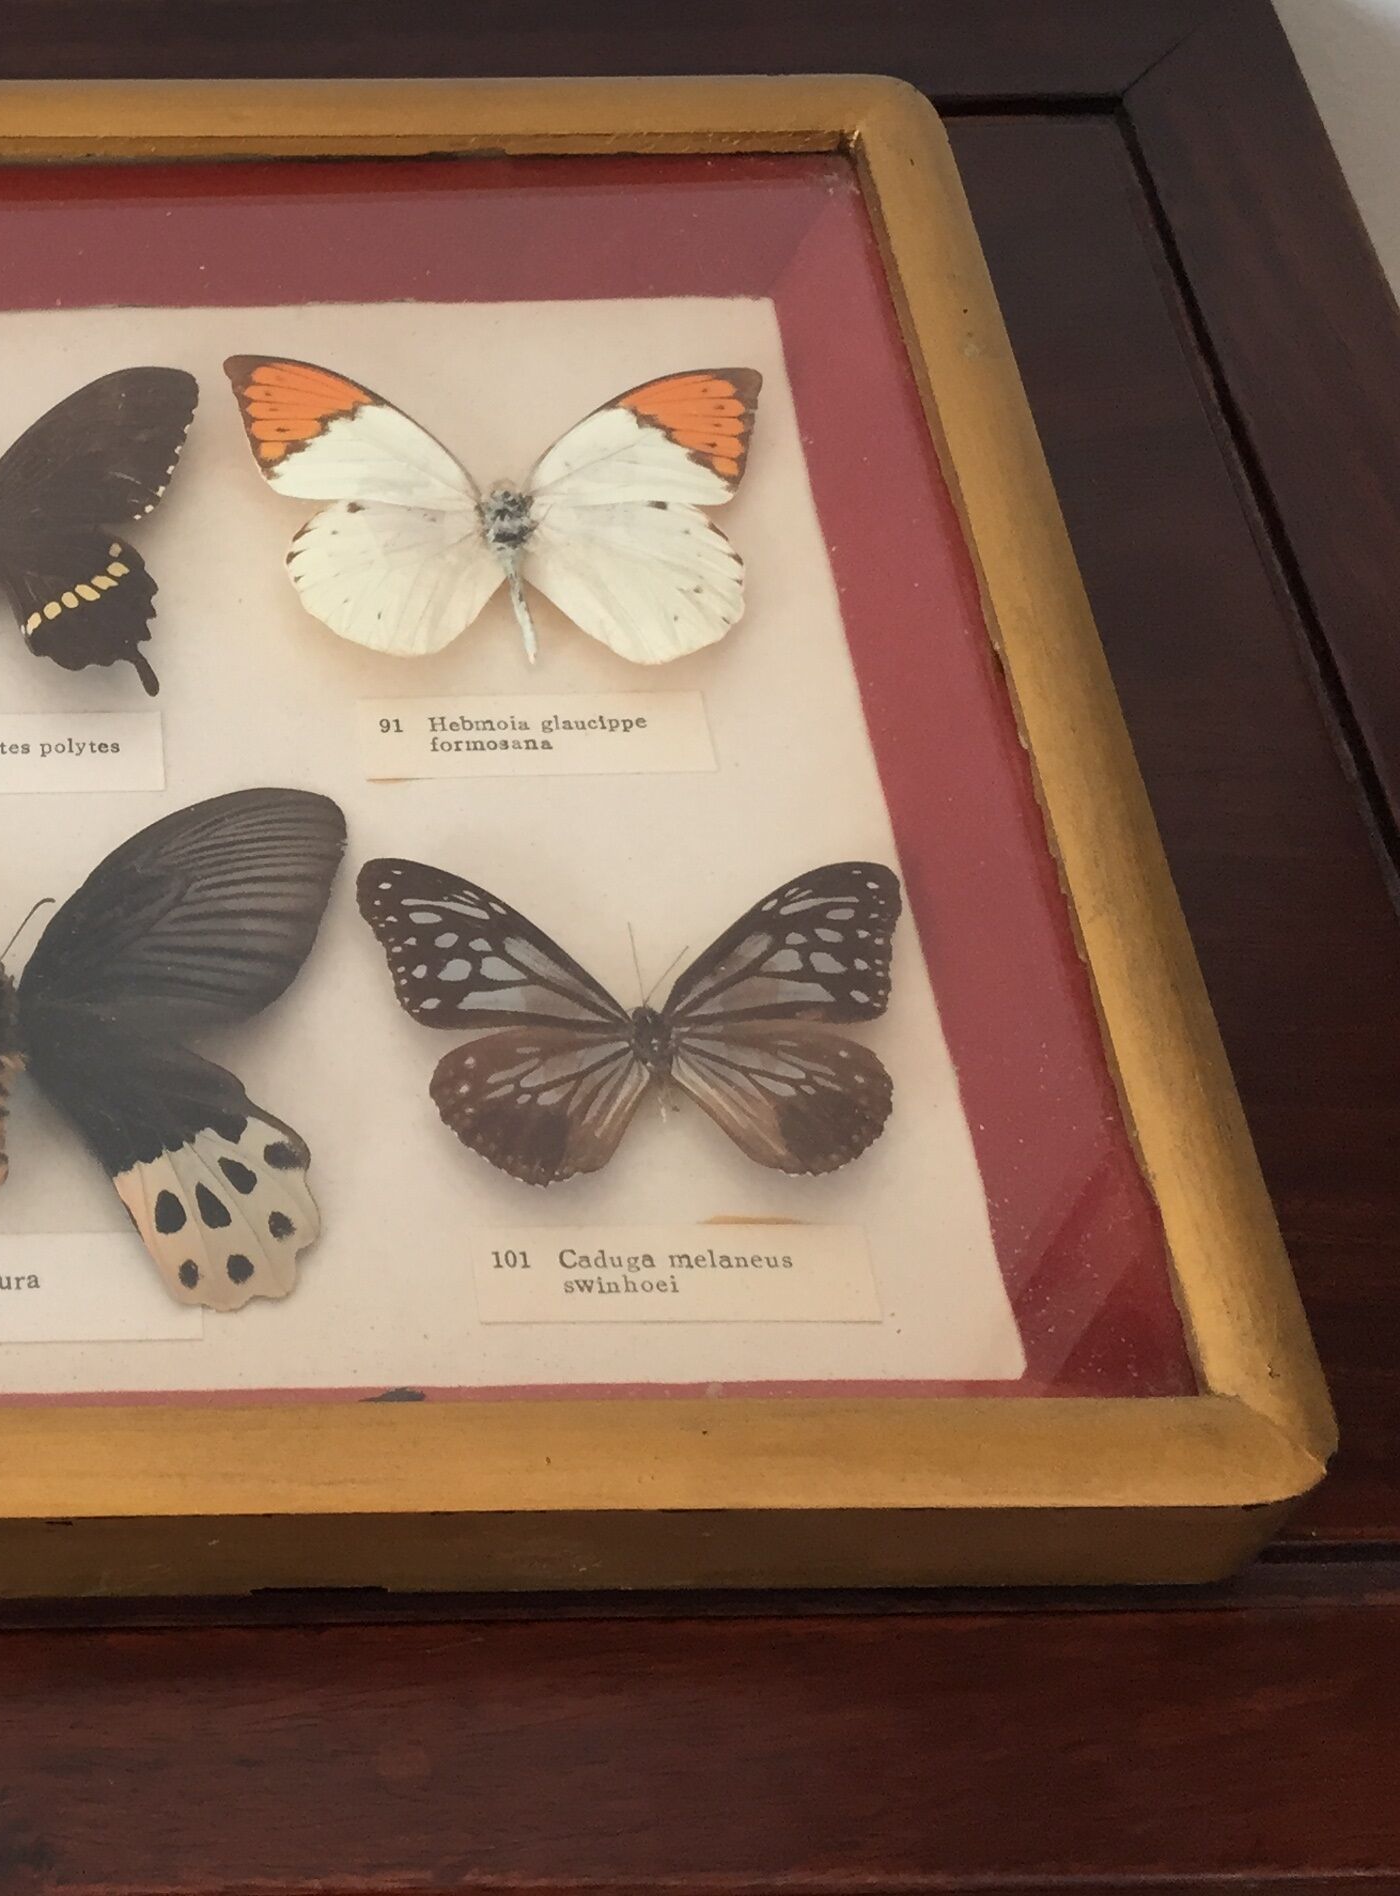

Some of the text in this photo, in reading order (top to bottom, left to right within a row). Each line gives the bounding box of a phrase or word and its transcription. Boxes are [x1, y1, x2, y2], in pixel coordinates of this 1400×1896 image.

[378, 714, 648, 734] 91 Hebmoia glaucippe
[39, 738, 121, 758] polytes
[429, 737, 554, 753] formosana
[491, 1248, 794, 1273] 101 Caduga melaneus
[563, 1275, 680, 1295] swinhoei
